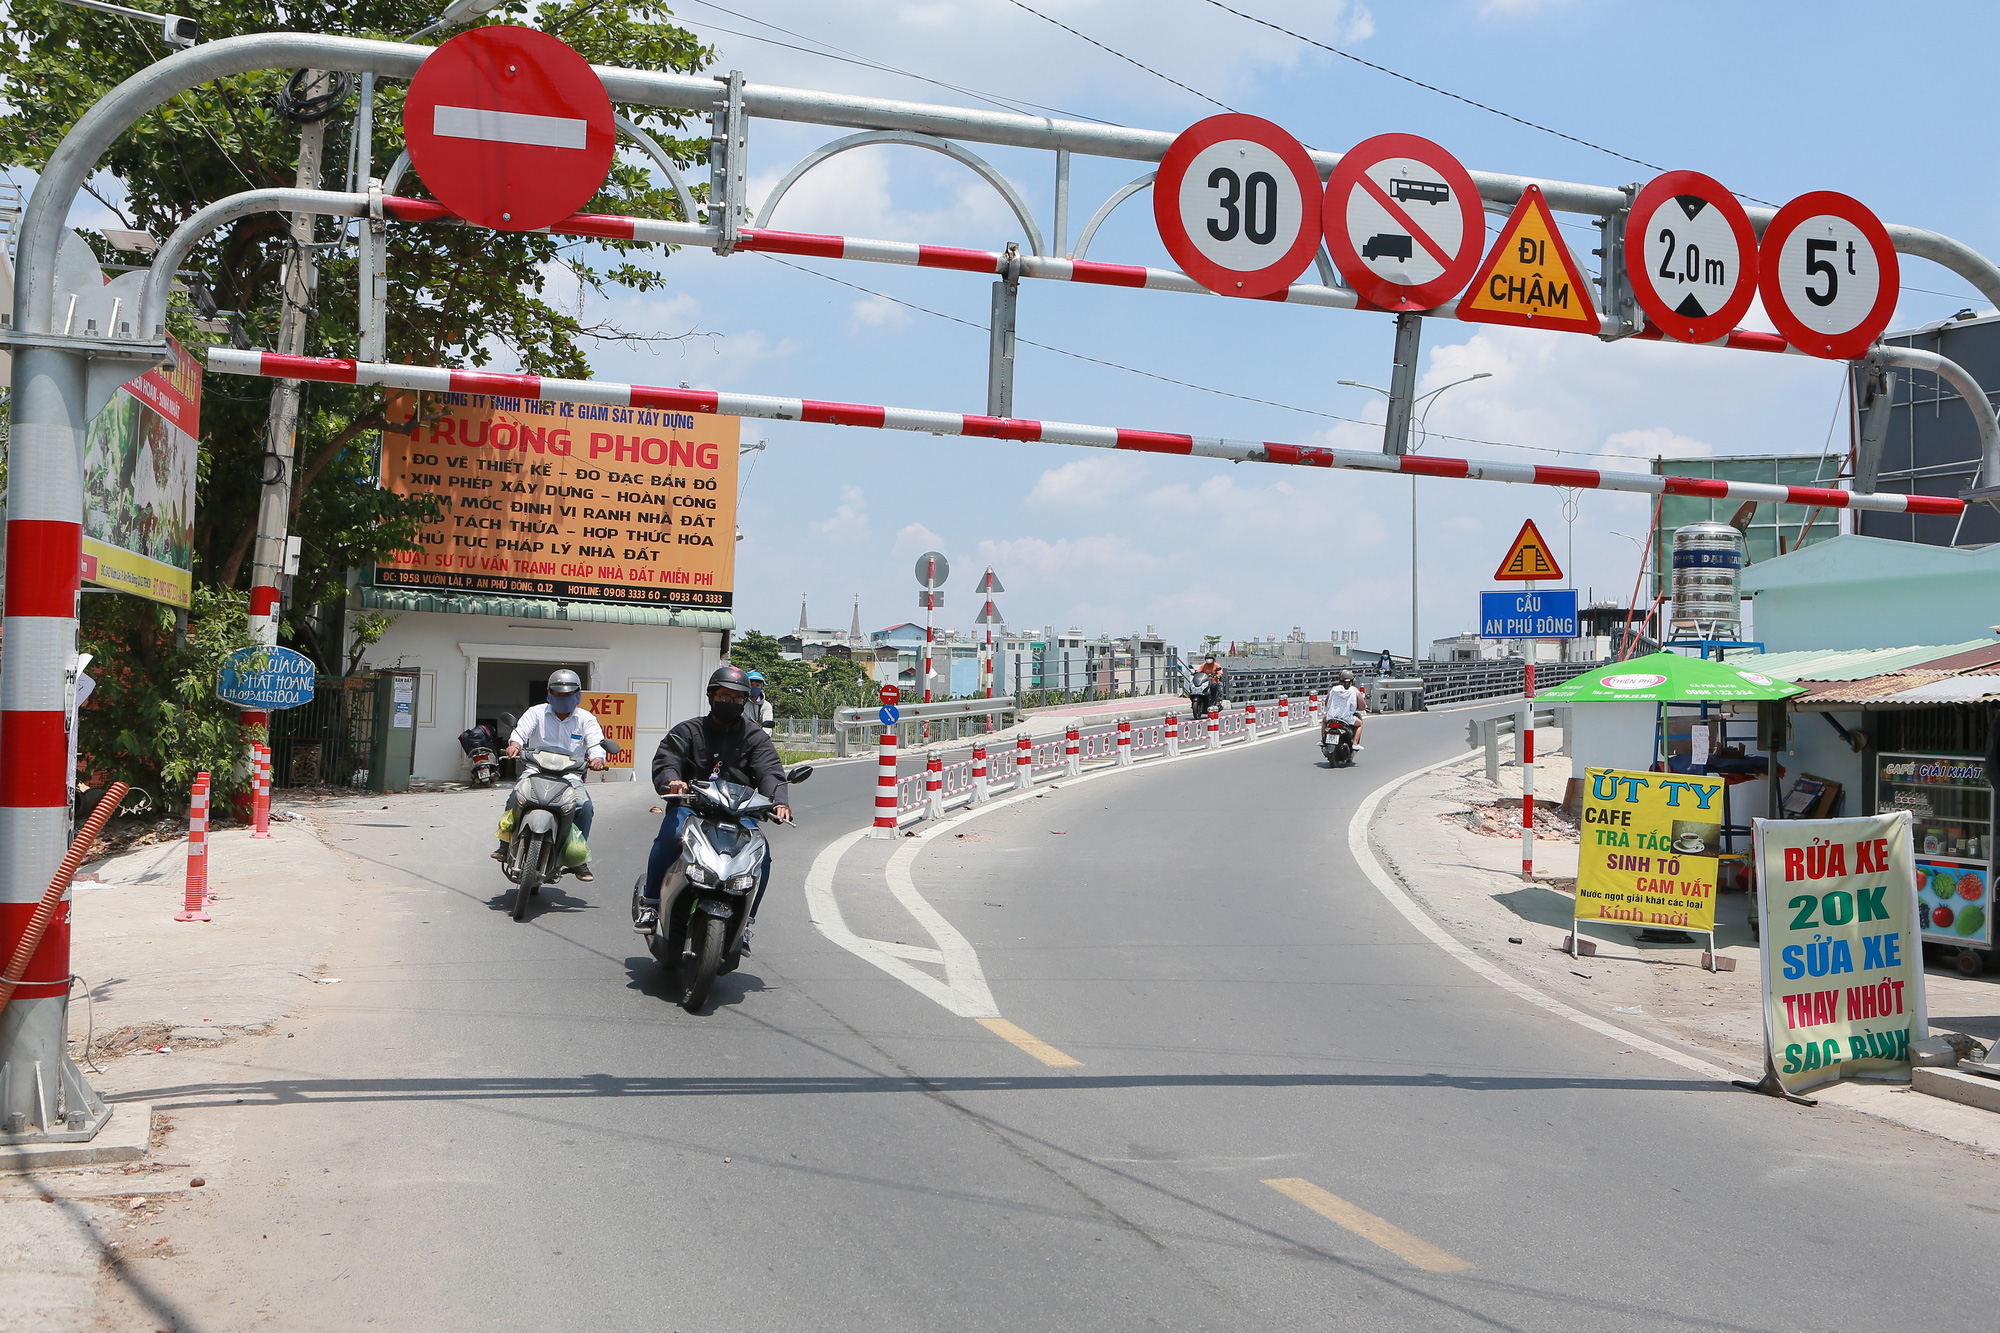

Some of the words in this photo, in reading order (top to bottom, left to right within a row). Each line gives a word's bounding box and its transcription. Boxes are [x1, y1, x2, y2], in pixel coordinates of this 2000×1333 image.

[1206, 167, 1278, 245] 30
[1518, 237, 1546, 265] ĐI
[1489, 272, 1569, 313] CHẬM
[472, 393, 488, 408] TY
[490, 395, 521, 412] TNHH
[637, 408, 659, 427] XÂY
[663, 411, 694, 431] DỰNG
[404, 413, 571, 456] TRƯỜNG
[590, 432, 719, 469] PHONG
[412, 453, 438, 466] ĐO
[446, 456, 468, 469] VẼ
[476, 459, 523, 473] THIẾT
[531, 462, 553, 477] KẾ
[575, 468, 601, 481] ĐO
[608, 471, 644, 486] ĐẠC
[651, 473, 686, 488] BẢN
[693, 476, 717, 490] ĐỒ
[410, 472, 441, 486] XIN
[449, 475, 493, 490] PHÉP
[501, 480, 538, 494] XÂY
[546, 485, 594, 499] DỰNG
[617, 491, 665, 505] HOÀN
[672, 494, 717, 509] CÔNG
[460, 495, 503, 511] MỐC
[510, 501, 551, 516] ĐỊNH
[559, 505, 576, 519] VỊ
[583, 507, 631, 521] RANH
[638, 512, 672, 525] NHÀ
[680, 513, 716, 528] ĐẤT
[454, 515, 502, 530] TÁCH
[510, 520, 559, 535] THỬA
[583, 526, 619, 541] HỢP
[626, 529, 671, 543] THỨC
[678, 532, 714, 546] HÓA
[453, 535, 488, 550] TỤC
[495, 538, 544, 552] PHÁP
[551, 541, 571, 555] LÝ
[578, 545, 615, 558] NHÀ
[623, 547, 660, 561] ĐẤT
[435, 553, 455, 567] SƯ
[458, 555, 478, 569] TƯ
[481, 554, 508, 571] VẤN
[514, 560, 556, 575] TRANH
[561, 560, 593, 578] CHẤP
[598, 565, 624, 580] NHÀ
[628, 565, 655, 582] ĐẤT
[660, 567, 690, 584] MIỄN
[694, 570, 714, 585] PHÍ
[383, 571, 397, 582] ĐC:
[399, 572, 420, 583] 1958
[422, 573, 446, 585] VƯỜN
[466, 577, 474, 587] P.
[476, 578, 488, 588] AN
[491, 578, 508, 589] PHÚ
[537, 582, 553, 593] Q.12
[568, 585, 601, 596] HOTLINE:
[603, 587, 626, 598] 0908
[628, 589, 646, 599] 3333
[648, 590, 660, 600] 60
[669, 592, 690, 603] 0933
[692, 593, 703, 603] 40
[705, 594, 723, 604] 3333
[1516, 592, 1541, 612] CẦU
[1485, 619, 1502, 634] AN
[1507, 615, 1533, 634] PHÚ
[1536, 616, 1573, 633] ĐÔNG
[589, 695, 624, 715] XÉT
[616, 725, 633, 740] TIN
[1886, 761, 1915, 775] CAFÉ
[1919, 762, 1945, 777] GIẢI
[1947, 765, 1983, 779] KHÁT
[1592, 769, 1650, 803] ÚT
[1659, 780, 1721, 809] TY
[1585, 807, 1632, 826] CAFE
[1596, 828, 1630, 848] TRÀ
[1637, 830, 1671, 851] TẮC
[1607, 853, 1650, 872] SINH
[1657, 854, 1682, 875] TỐ
[1784, 837, 1847, 882] RỬA
[1855, 838, 1890, 875] XE
[1580, 889, 1602, 899] Nước
[1605, 892, 1624, 903] ngọt
[1626, 893, 1643, 903] giải
[1646, 895, 1665, 905] khát
[1668, 898, 1684, 907] các
[1686, 899, 1703, 910] loại
[1637, 877, 1674, 894] CAM
[1681, 878, 1712, 898] VẮT
[1599, 904, 1644, 922] Kính
[1651, 910, 1689, 927] mời
[1788, 886, 1890, 931] 20K
[1782, 934, 1854, 980] SỬA
[1862, 933, 1902, 970] XE
[1782, 989, 1839, 1030] THAY
[1847, 977, 1905, 1021] NHỚT
